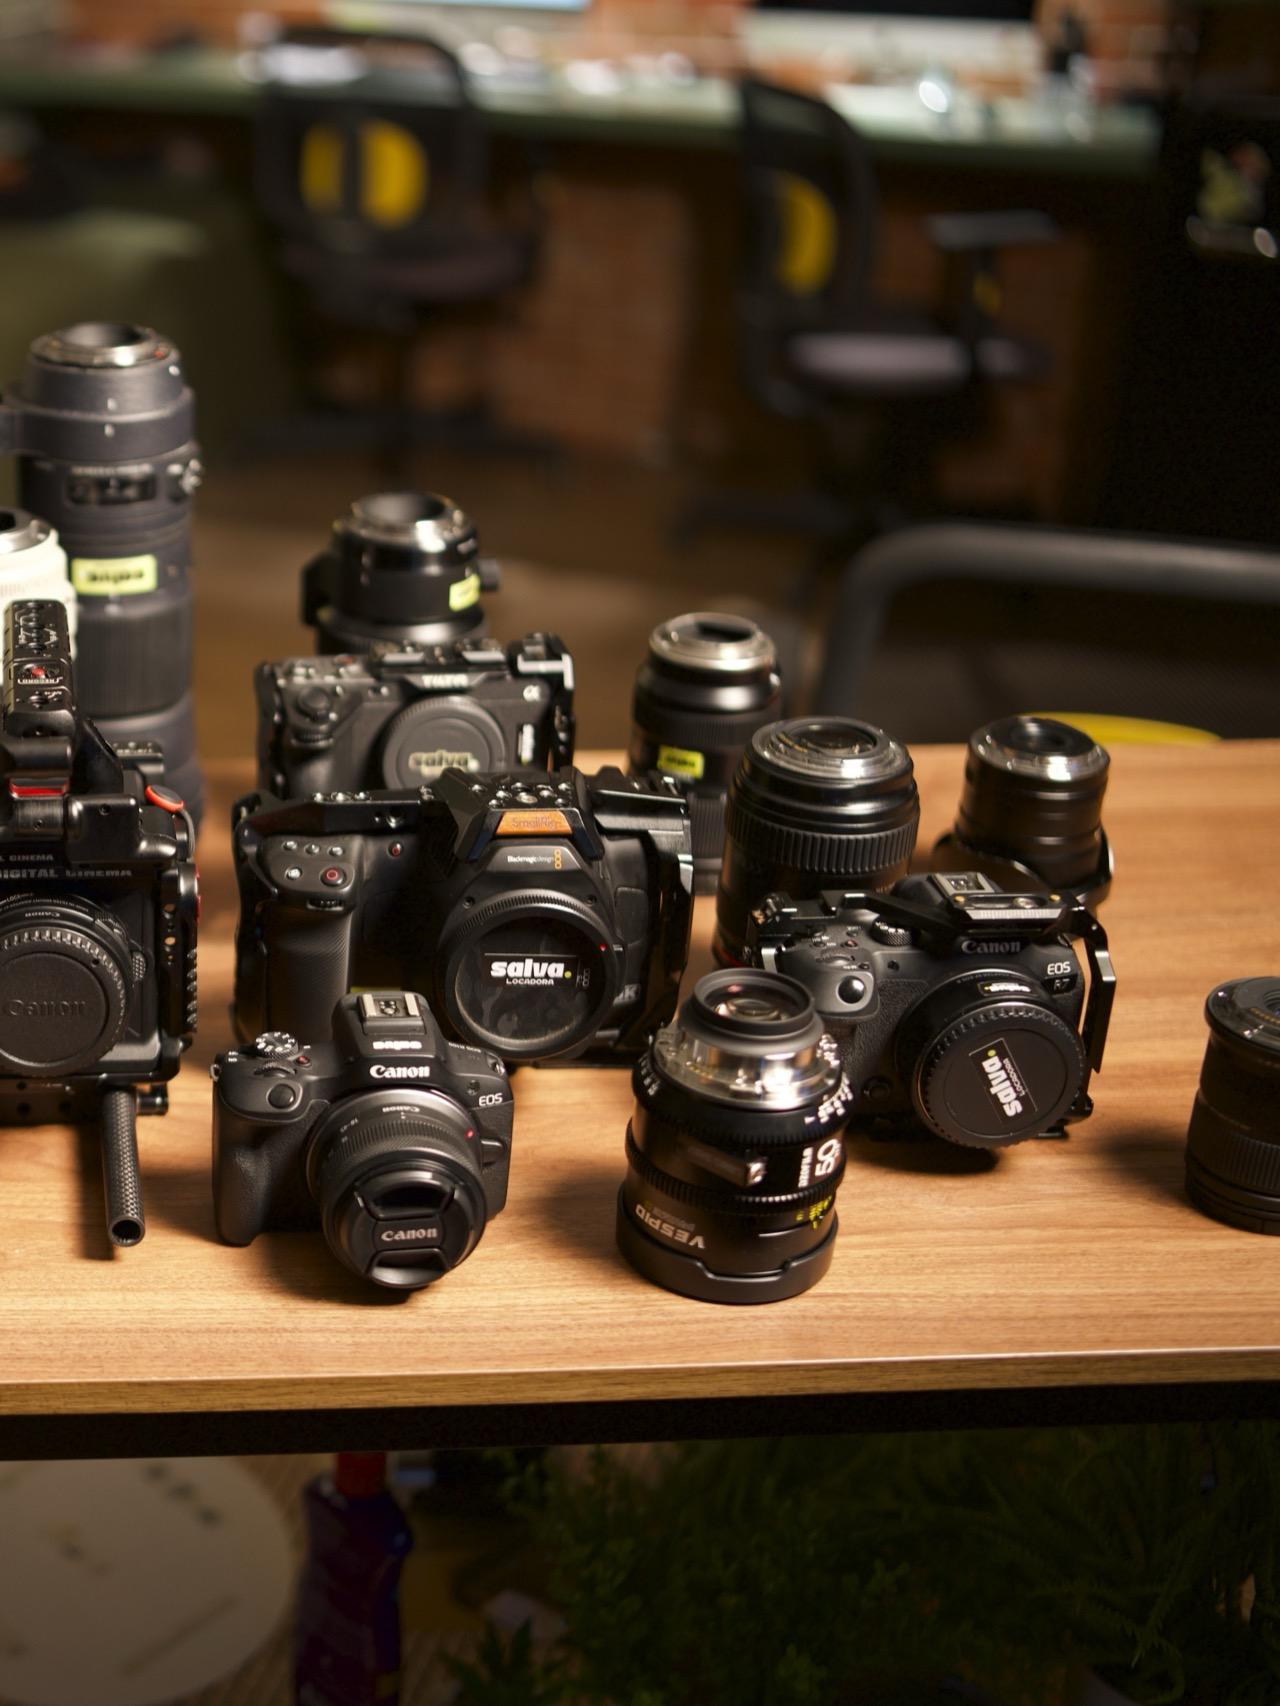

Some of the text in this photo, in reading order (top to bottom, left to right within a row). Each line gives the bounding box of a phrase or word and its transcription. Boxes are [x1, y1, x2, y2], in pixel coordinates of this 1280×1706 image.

[9, 854, 54, 862] CINEMA
[66, 869, 132, 877] CINEMA
[961, 940, 1020, 954] Canon
[1047, 961, 1071, 975] EOS
[1053, 979, 1070, 992] R7
[2, 1000, 86, 1016] Canon
[370, 1065, 431, 1079] Canon
[479, 1093, 503, 1107] EOS
[815, 1138, 841, 1177] 50
[635, 1204, 706, 1249] VESPID
[381, 1228, 438, 1241] Canon
